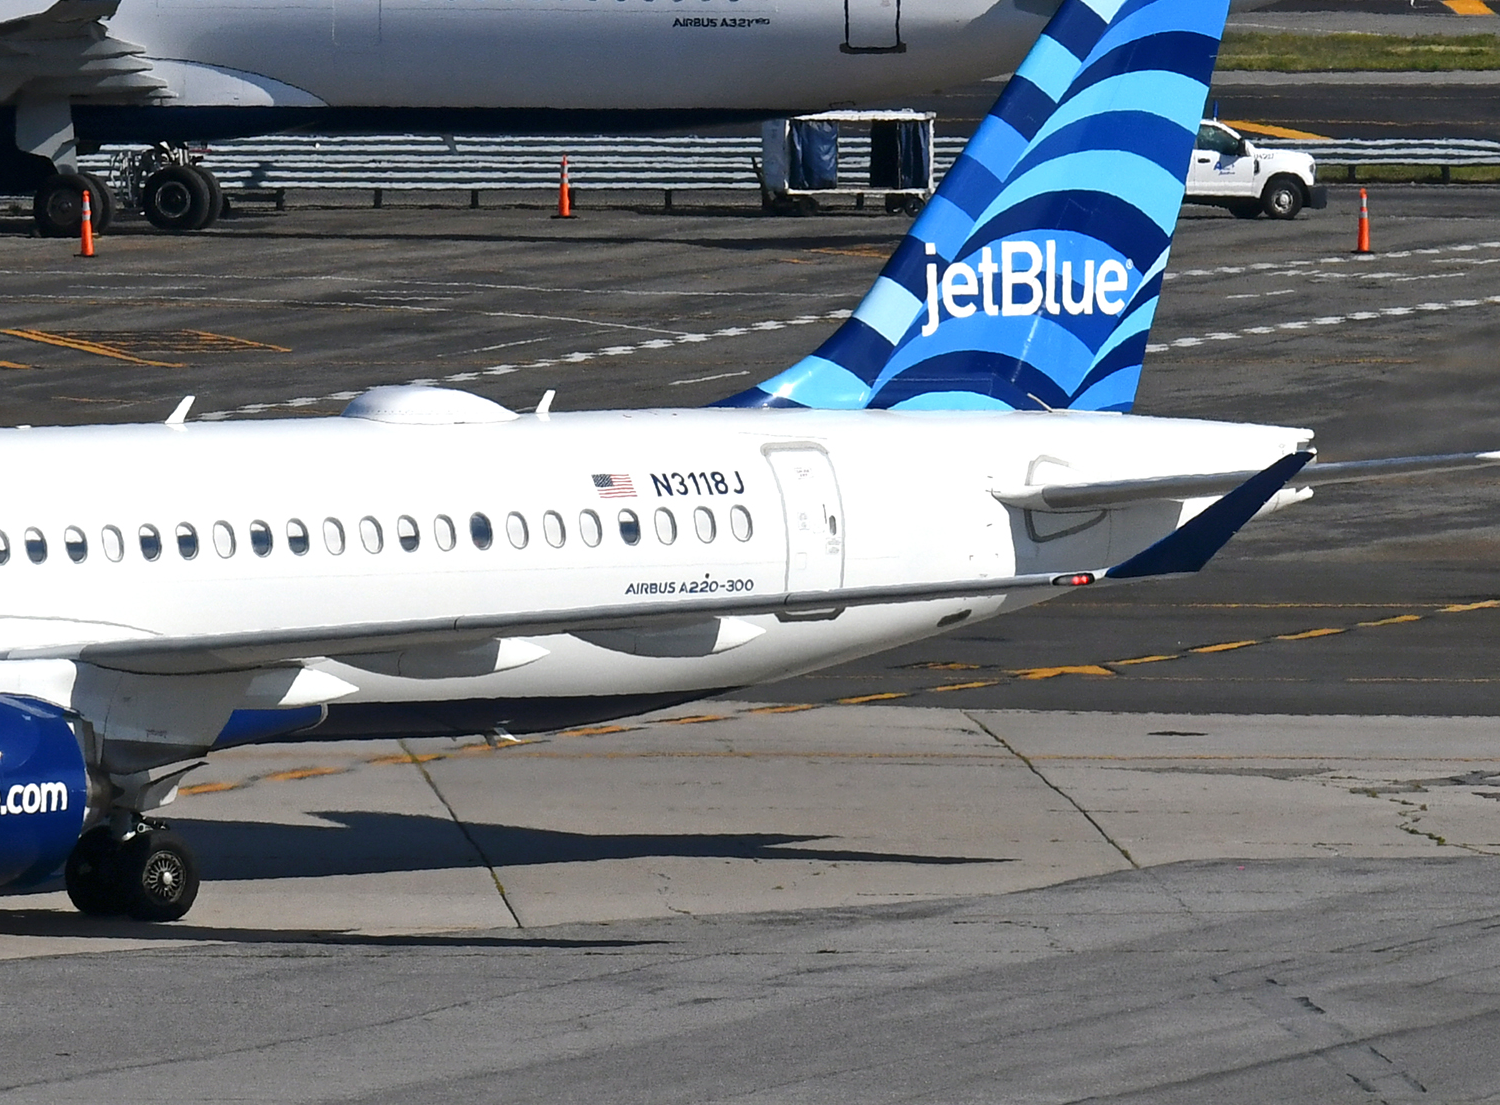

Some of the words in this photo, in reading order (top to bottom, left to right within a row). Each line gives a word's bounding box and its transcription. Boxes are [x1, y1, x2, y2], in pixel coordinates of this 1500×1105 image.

[672, 17, 718, 28] AIRBUS
[649, 471, 745, 497] N3118J
[625, 581, 676, 595] AIRBUS
[678, 578, 755, 594] A220-300
